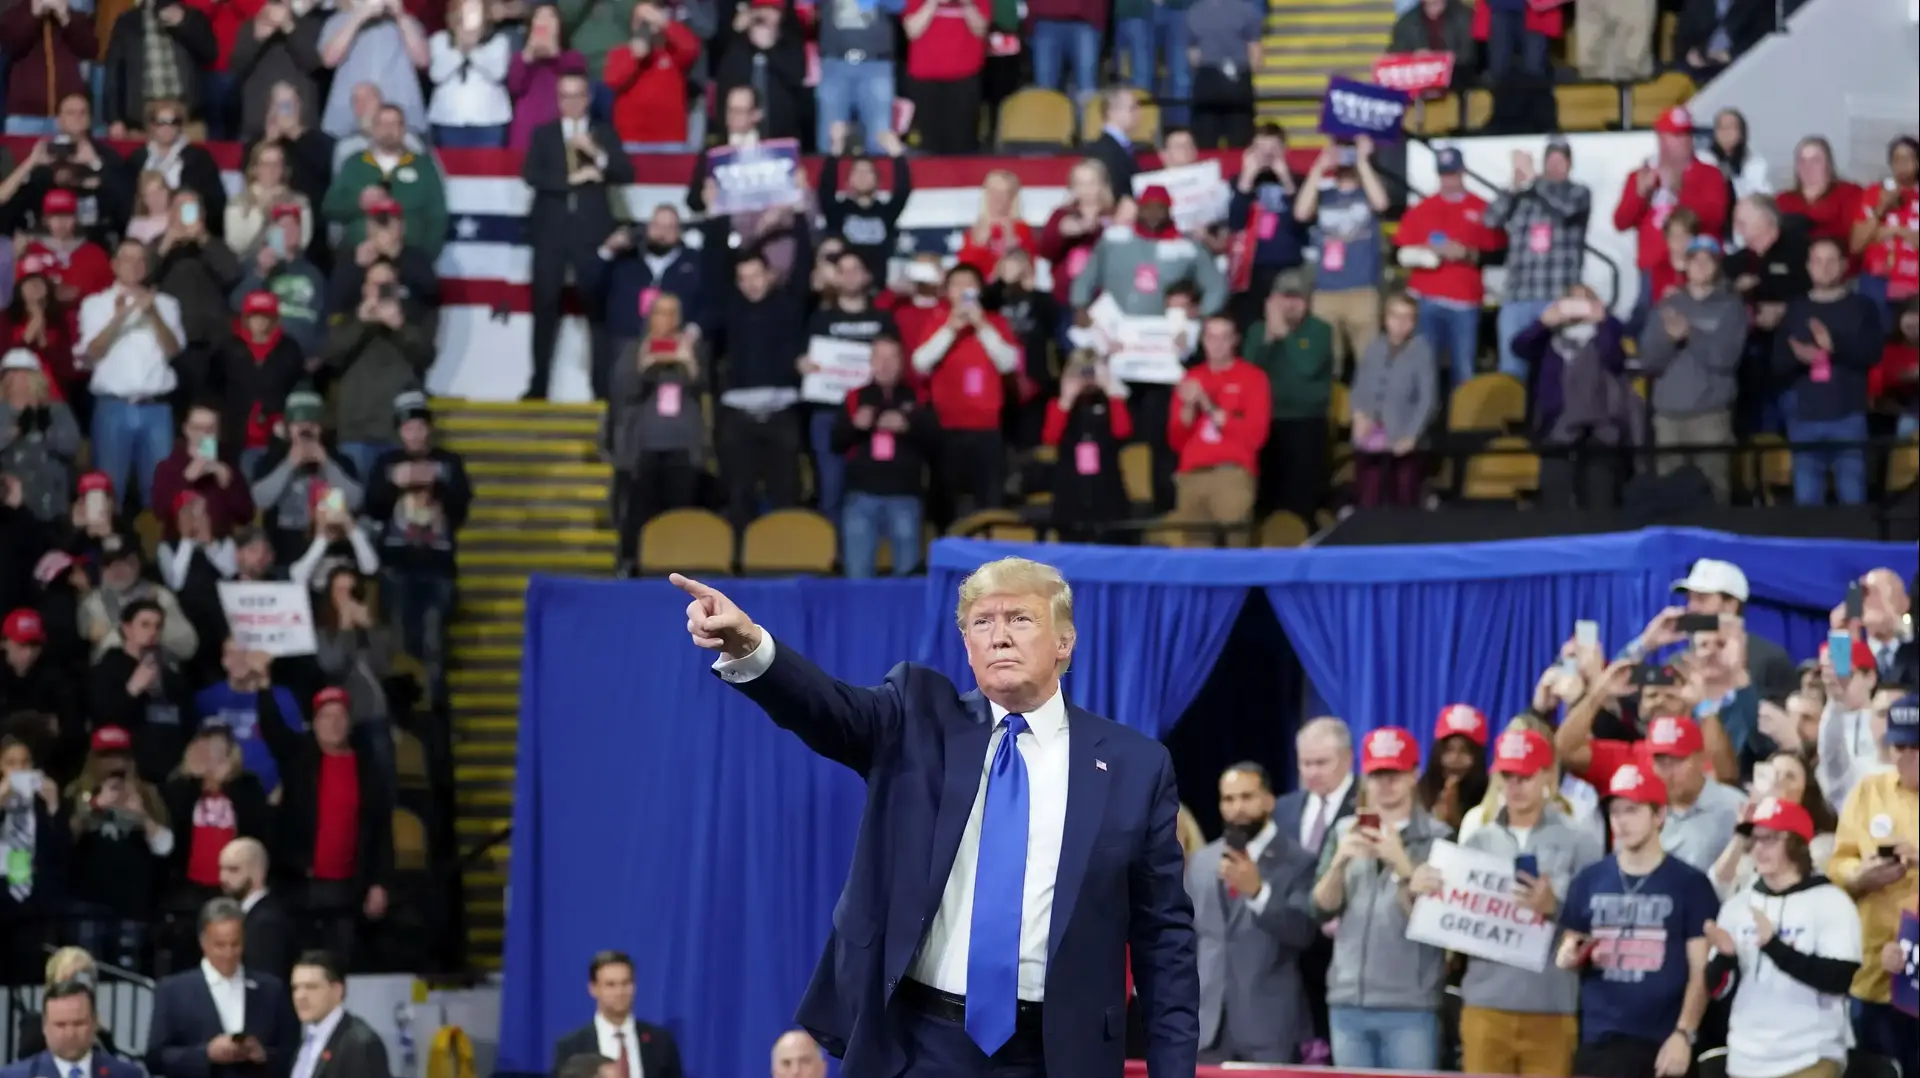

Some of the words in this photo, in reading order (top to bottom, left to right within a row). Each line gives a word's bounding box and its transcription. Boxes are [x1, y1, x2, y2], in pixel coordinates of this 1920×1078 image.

[1330, 88, 1404, 121] TRUMP
[1467, 869, 1512, 894] KEE
[1427, 887, 1546, 930] AMERICA
[1589, 892, 1674, 928] TRUMP
[1440, 913, 1525, 949] GREAT!
